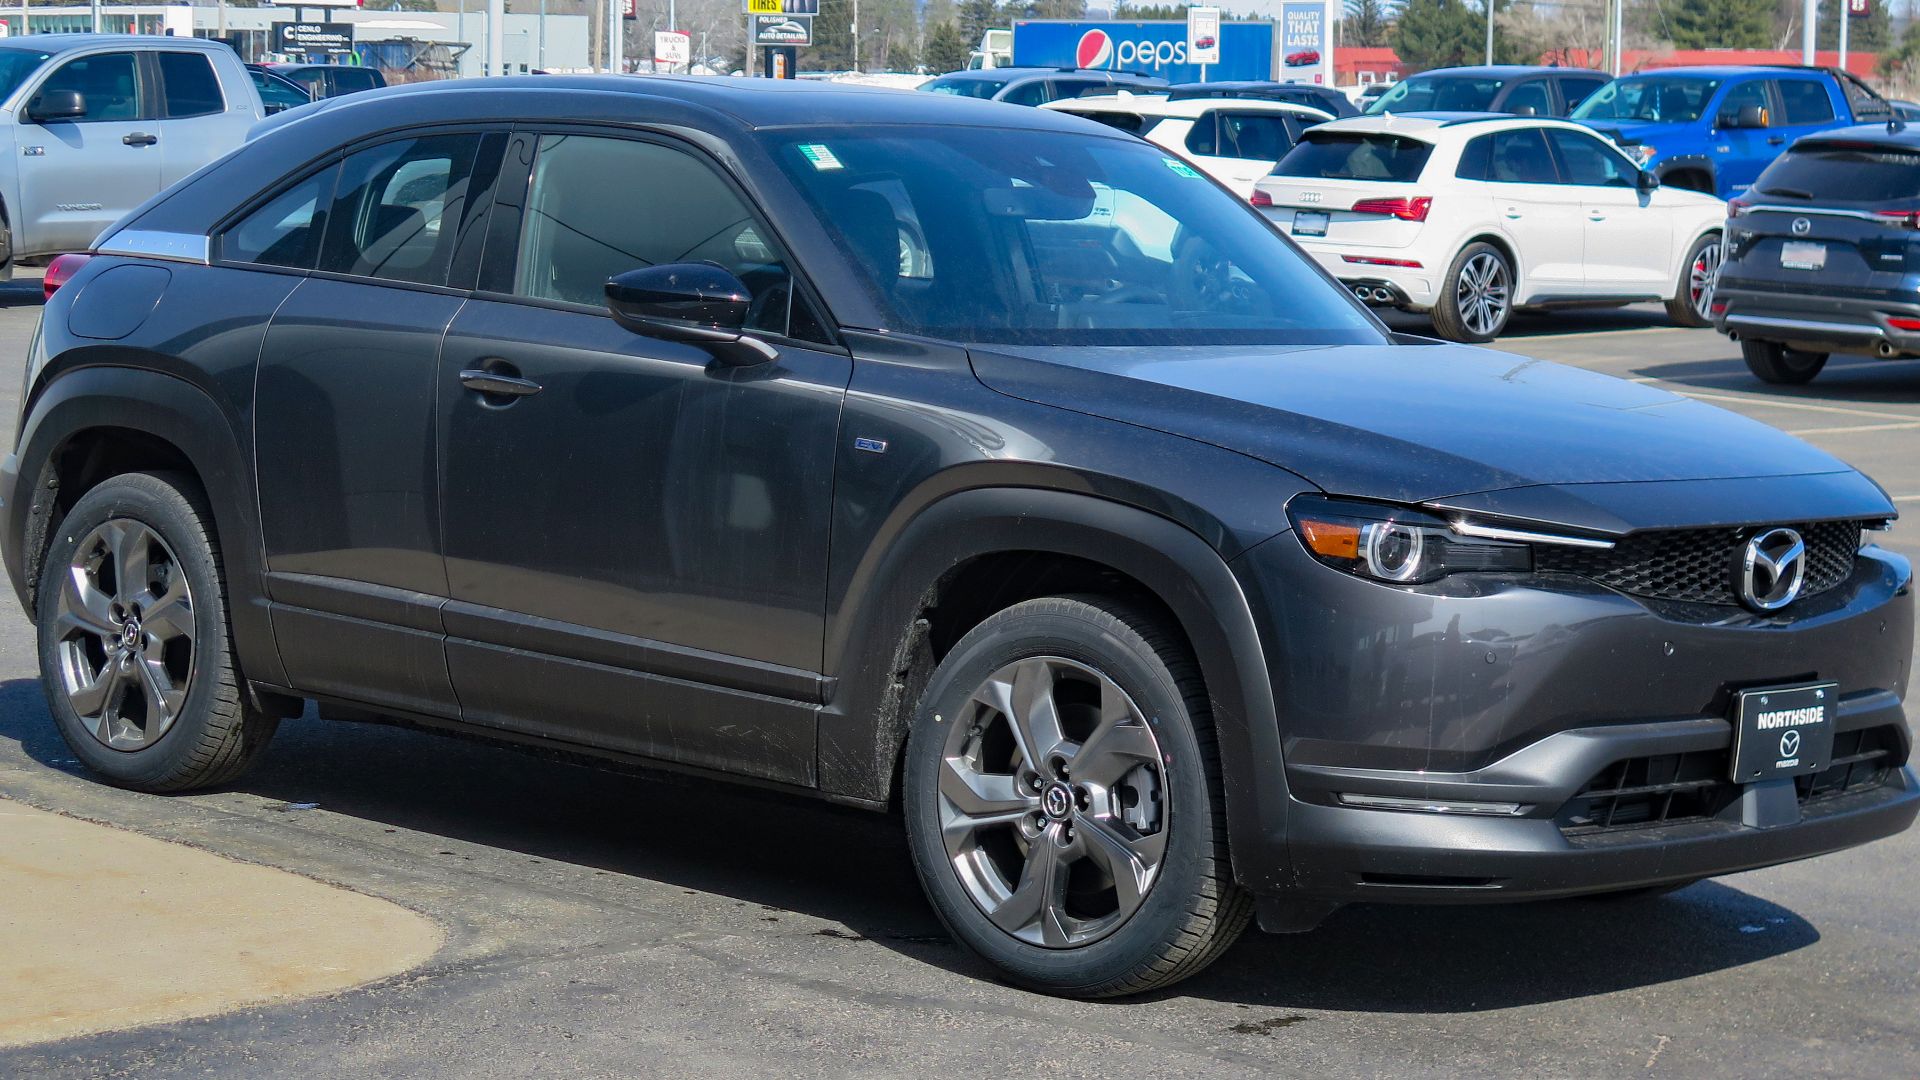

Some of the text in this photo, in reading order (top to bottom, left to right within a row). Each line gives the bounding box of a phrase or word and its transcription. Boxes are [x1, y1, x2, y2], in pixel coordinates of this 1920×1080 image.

[753, 0, 777, 10] TIRES
[1287, 11, 1320, 20] QUALITY
[1287, 21, 1319, 33] THAT
[297, 34, 342, 42] ENGINEERING
[1287, 35, 1319, 46] LASTS
[1117, 40, 1187, 71] peps
[1757, 706, 1824, 730] NORTHSIDE
